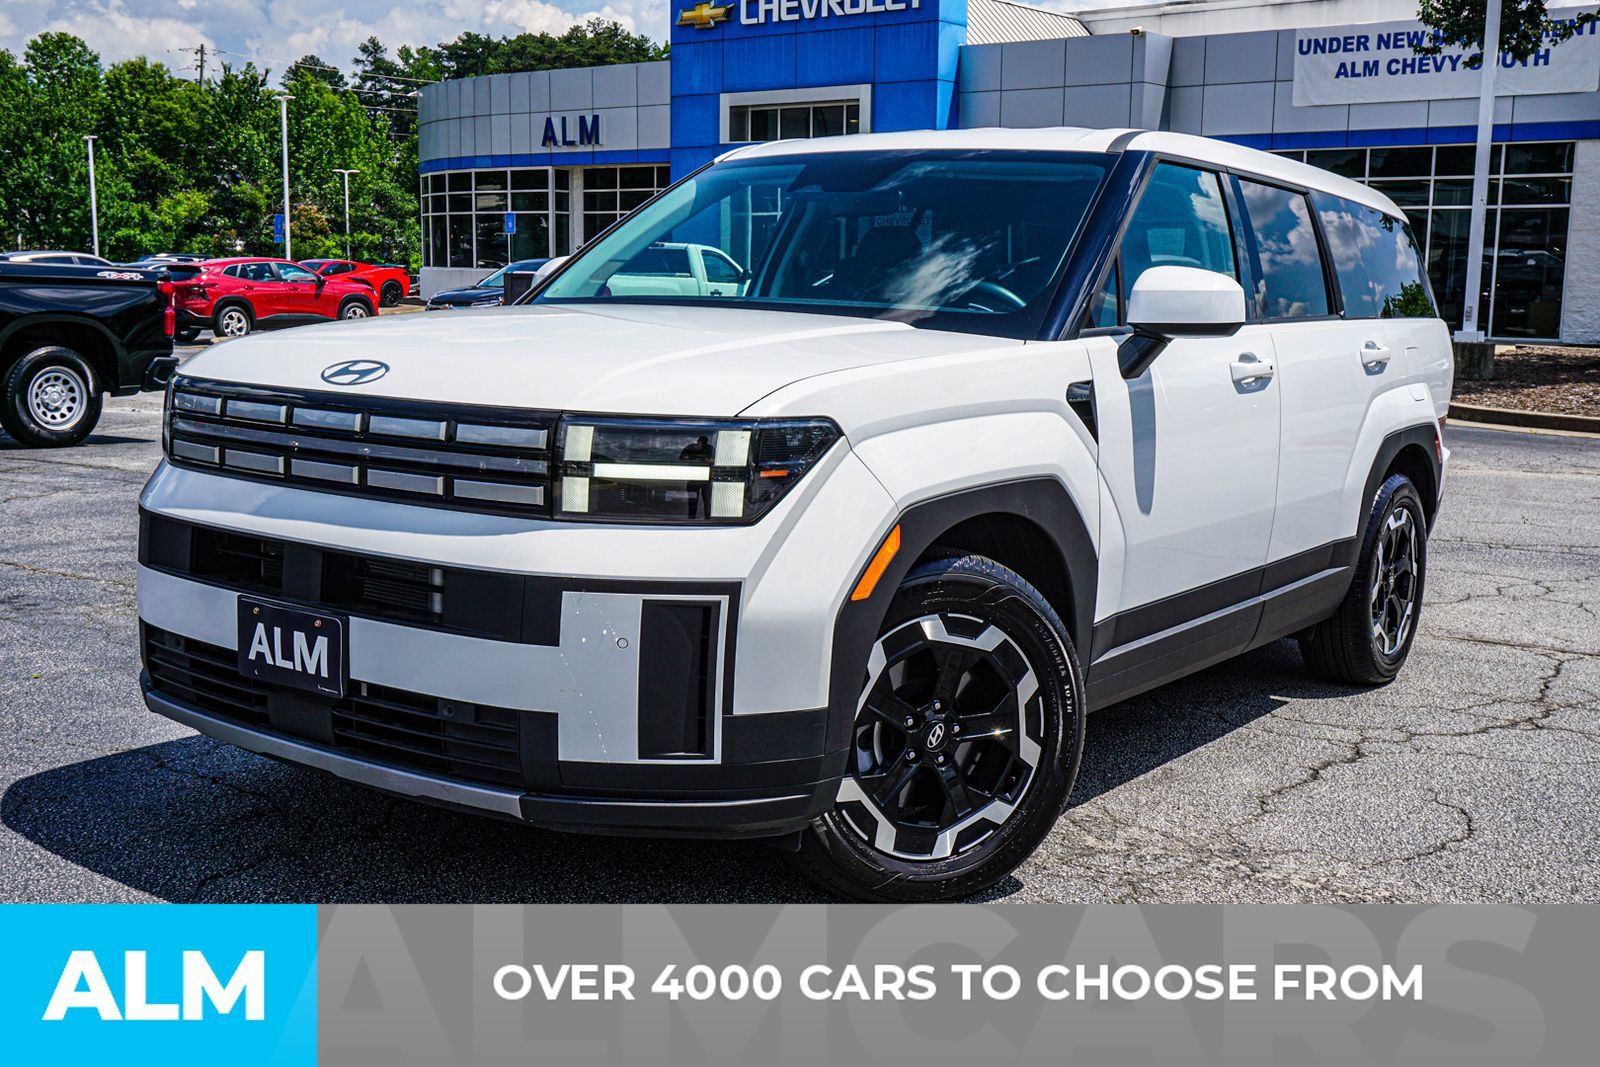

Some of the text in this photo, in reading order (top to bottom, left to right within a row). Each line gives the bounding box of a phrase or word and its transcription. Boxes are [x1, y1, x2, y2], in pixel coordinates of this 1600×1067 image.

[740, 0, 920, 25] CHEVRO
[1298, 34, 1370, 56] UNDER
[1376, 30, 1426, 50] NEW
[1334, 60, 1380, 79] ALM
[1386, 54, 1463, 76] CHEVY
[541, 115, 601, 147] ALM
[248, 621, 329, 679] ALM
